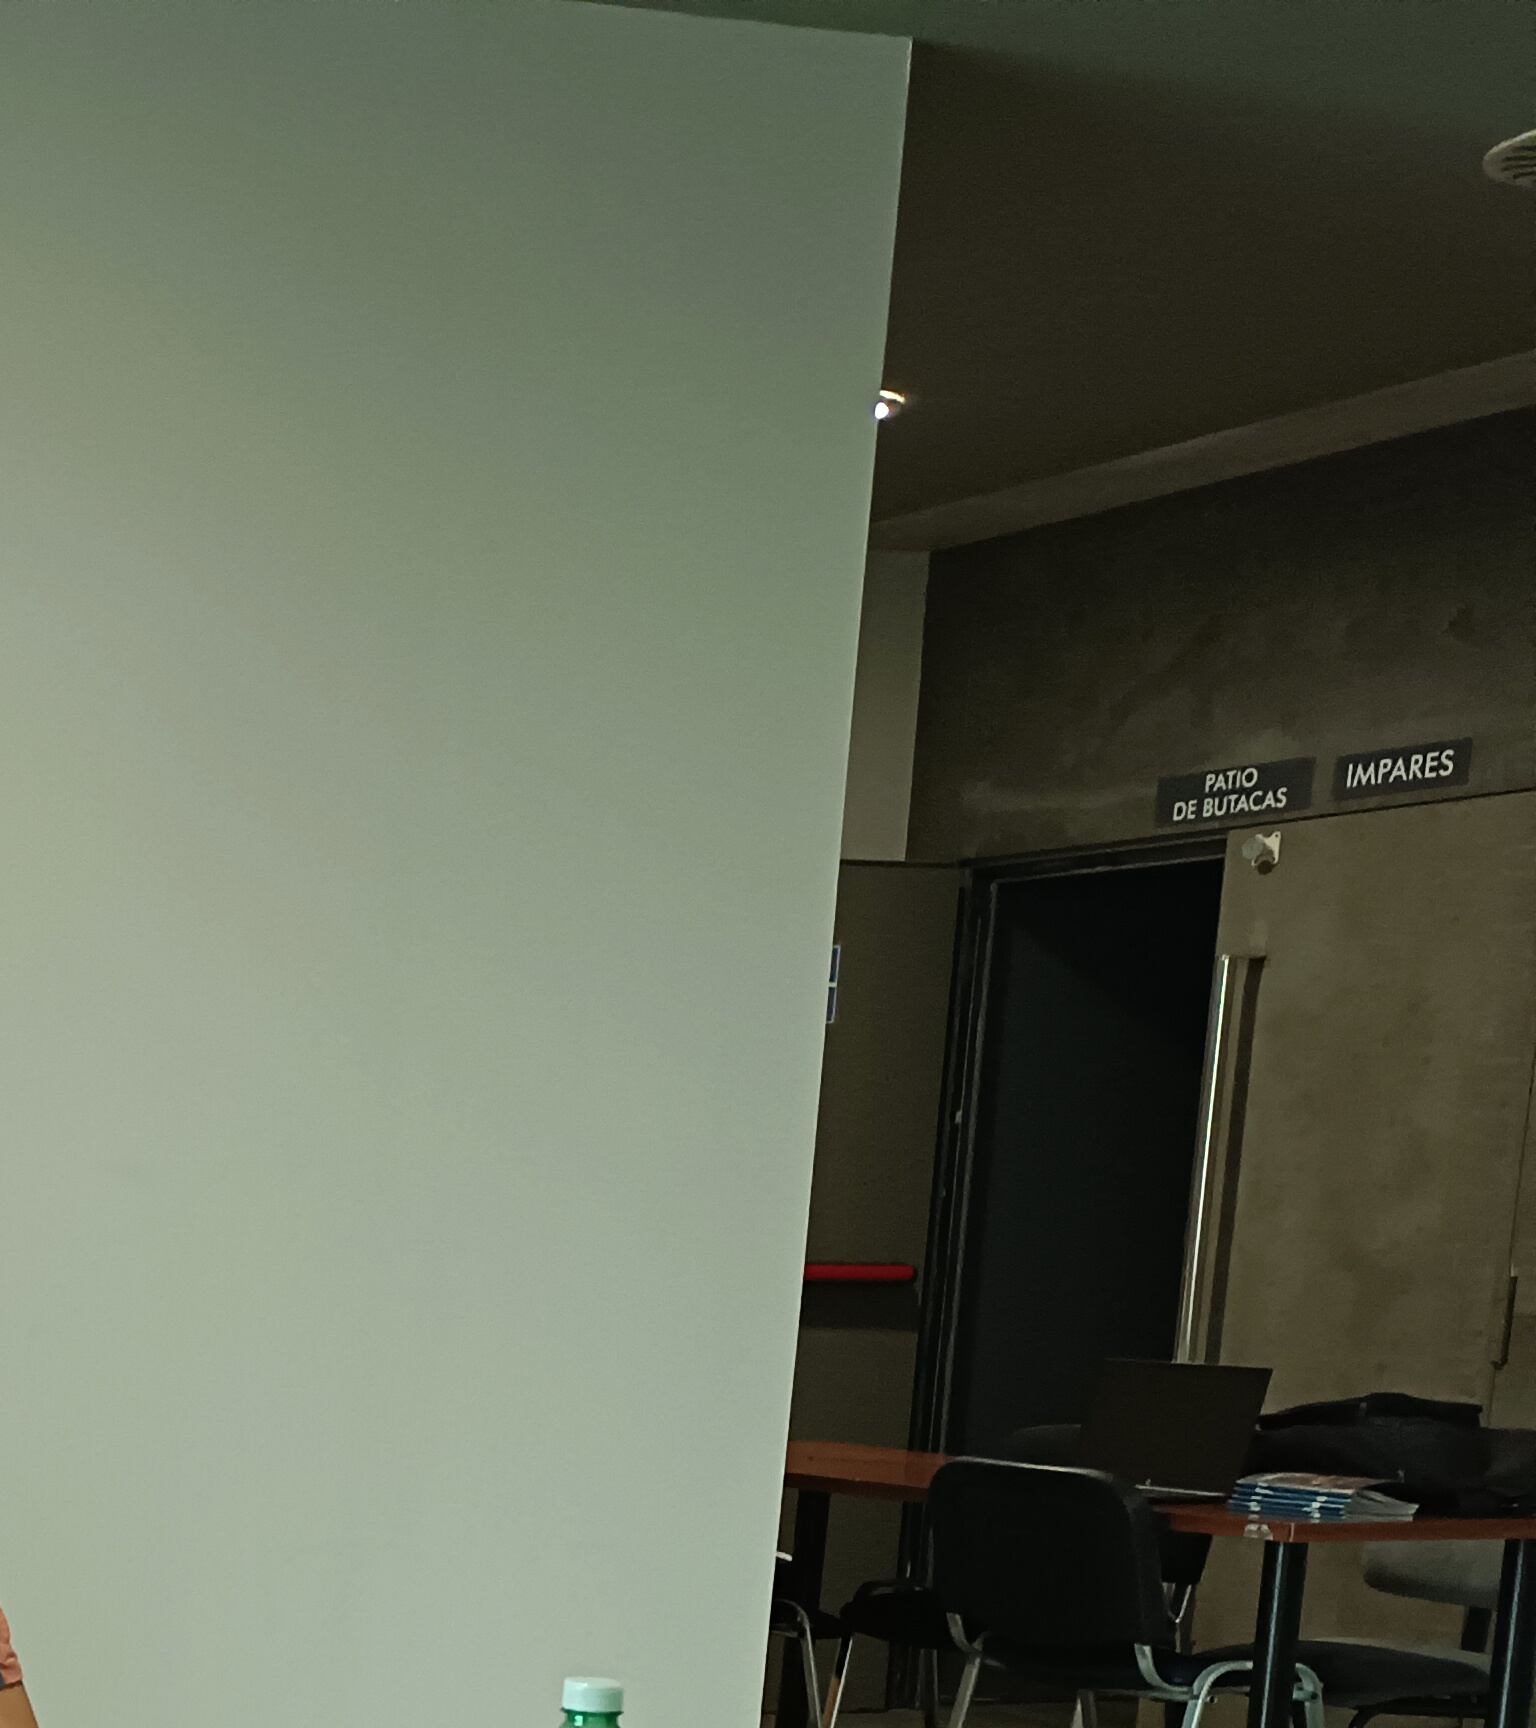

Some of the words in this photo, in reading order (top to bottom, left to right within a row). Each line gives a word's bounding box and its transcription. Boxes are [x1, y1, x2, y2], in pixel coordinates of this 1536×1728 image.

[1204, 767, 1258, 793] PATIO
[1346, 748, 1455, 789] IMPARES
[1172, 799, 1196, 821] DE
[1202, 787, 1288, 817] BUTACAS
